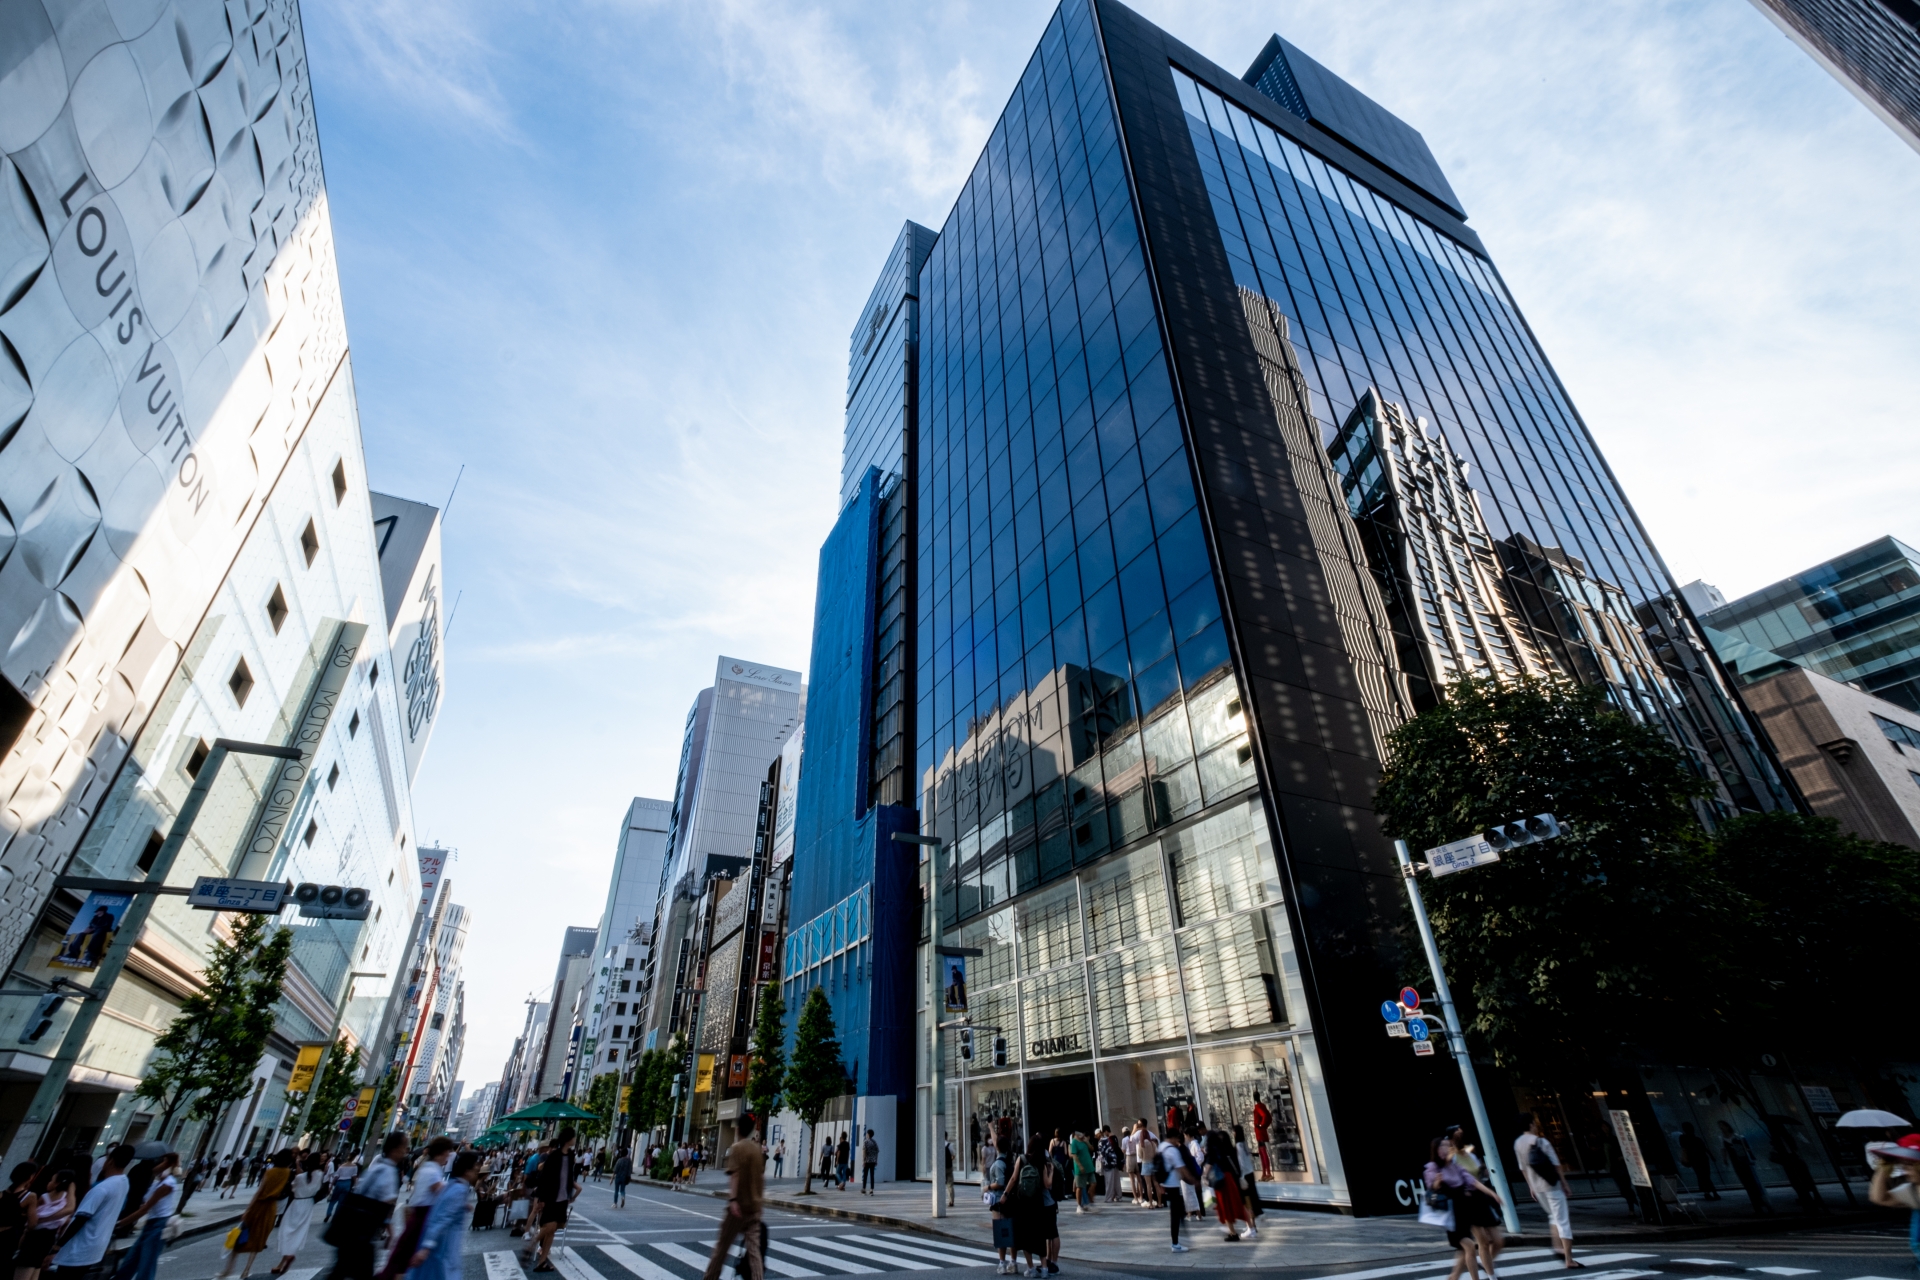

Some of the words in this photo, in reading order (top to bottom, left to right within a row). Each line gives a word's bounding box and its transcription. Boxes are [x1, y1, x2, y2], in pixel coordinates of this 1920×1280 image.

[60, 172, 144, 345] LOUIS
[136, 342, 210, 517] VUITTON
[744, 667, 768, 682] Loro
[768, 673, 794, 687] Piana
[1433, 841, 1491, 867] 銀座二丁目
[1452, 860, 1469, 869] Ginza
[197, 884, 278, 902] 銀座二丁目
[218, 897, 241, 906] Ginza
[244, 899, 250, 907] 2
[593, 966, 609, 1014] 教文館
[1032, 1034, 1082, 1056] CHANEL
